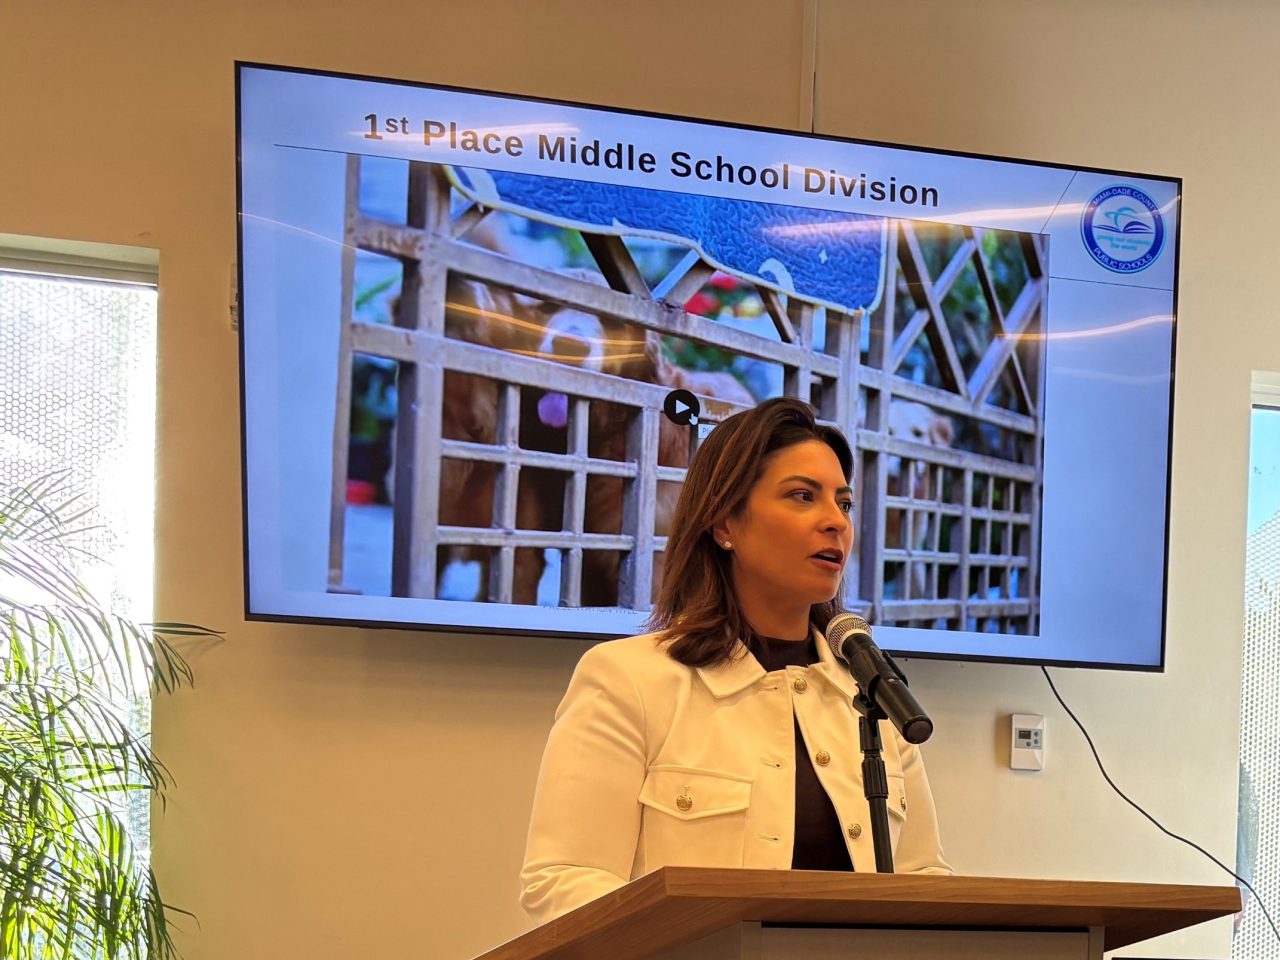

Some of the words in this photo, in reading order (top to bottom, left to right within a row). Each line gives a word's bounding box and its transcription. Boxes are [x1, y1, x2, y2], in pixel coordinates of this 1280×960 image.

[363, 113, 409, 141] 1st
[422, 119, 524, 157] Place
[537, 133, 657, 174] Middle
[669, 150, 789, 190] School
[803, 167, 939, 207] Division
